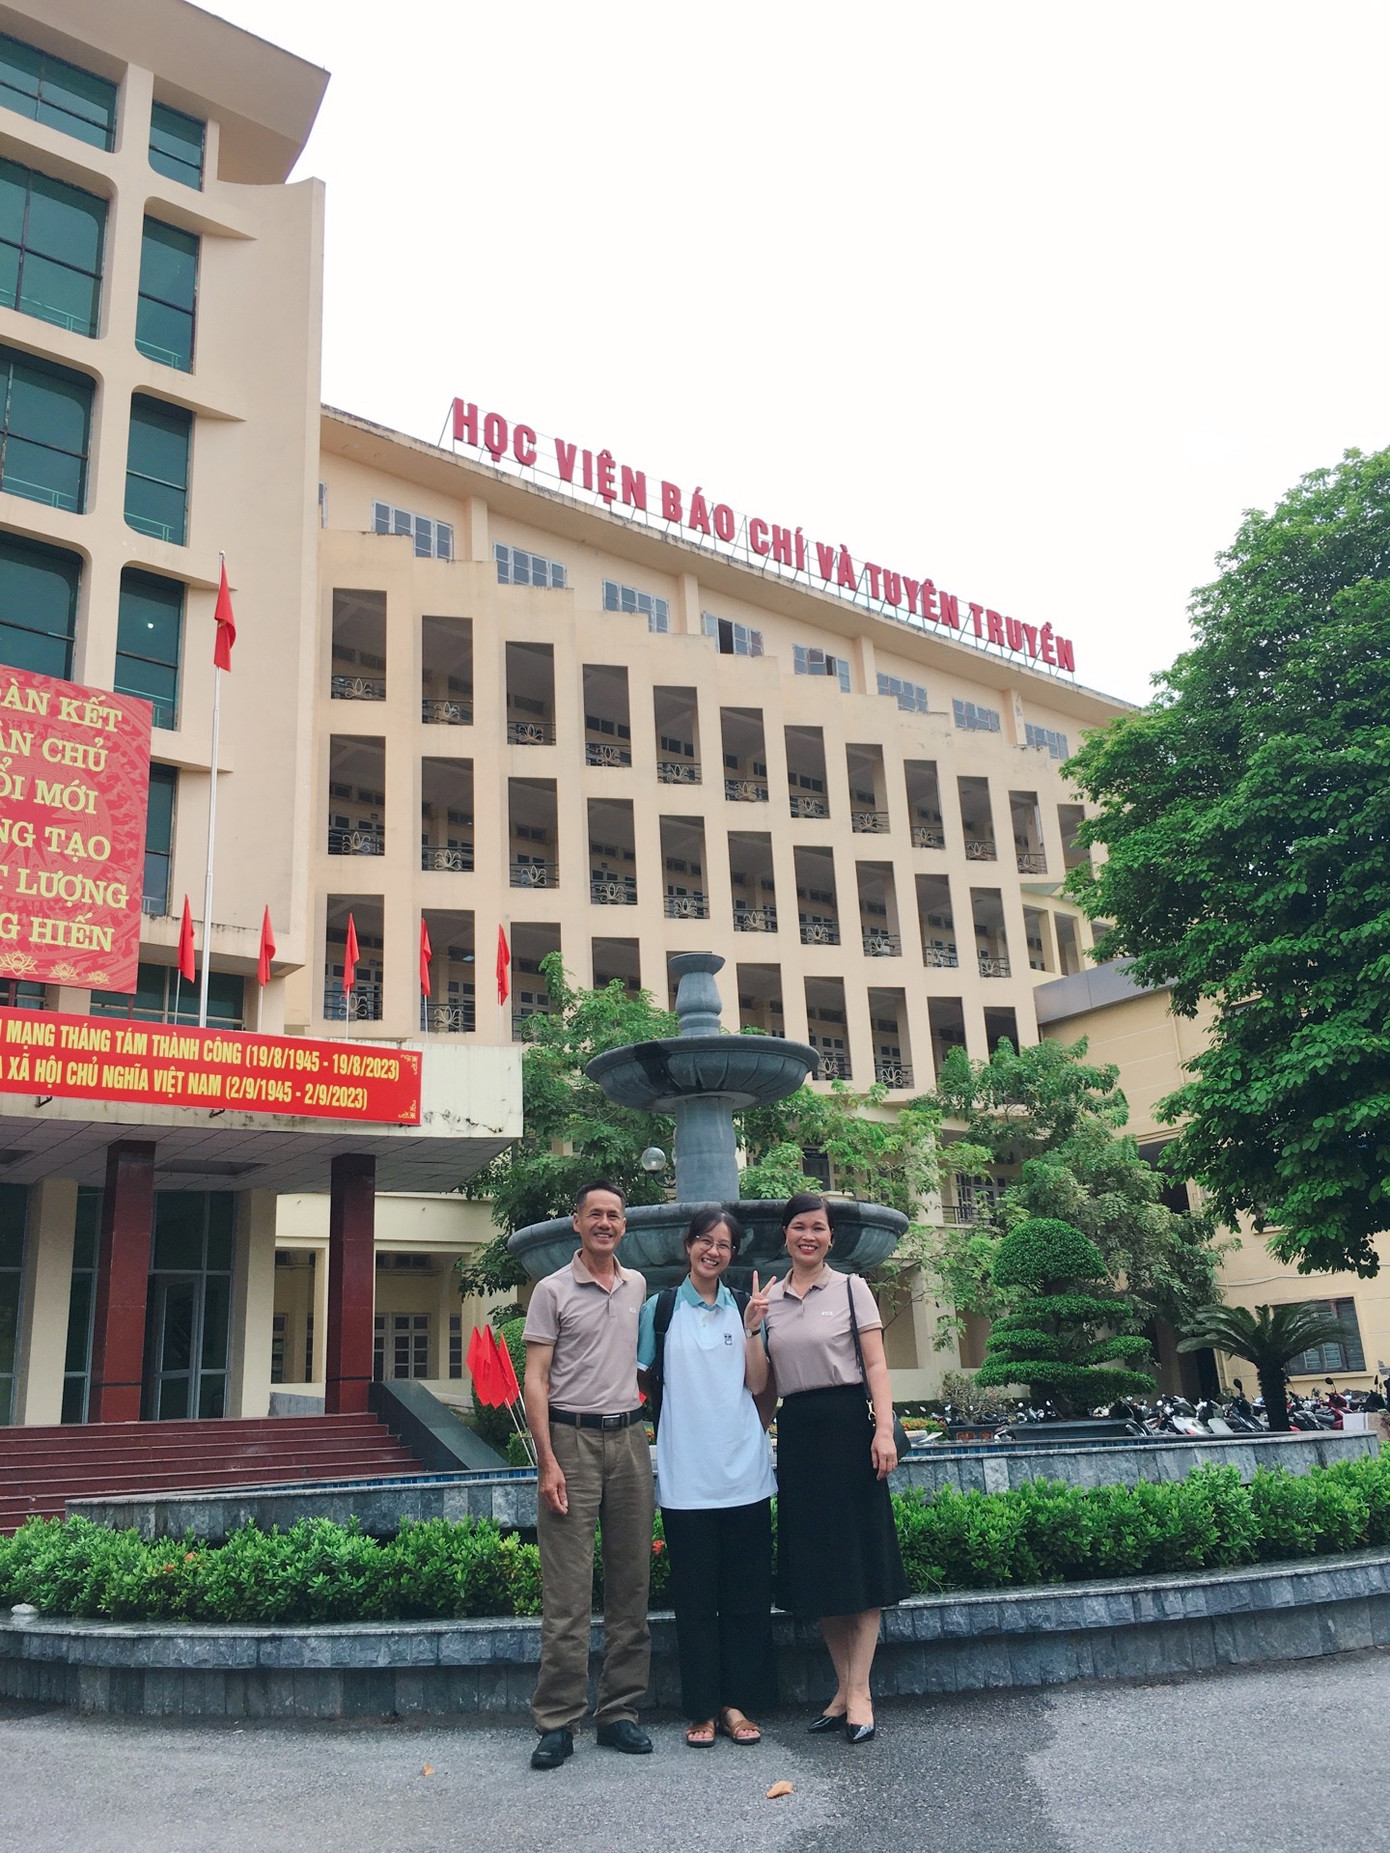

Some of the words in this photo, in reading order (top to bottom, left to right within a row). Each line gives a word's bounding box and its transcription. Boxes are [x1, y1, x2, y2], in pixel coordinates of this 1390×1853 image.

[453, 397, 537, 466] HỌC
[554, 437, 647, 510] VIỆN
[661, 480, 735, 542] BÁO
[749, 517, 805, 571] CHÍ
[816, 544, 857, 591] VÀ
[865, 562, 960, 630] TUYÊN
[968, 602, 1076, 672] TRUYỀN
[0, 677, 51, 716] ÀN
[58, 695, 122, 733] KẾT
[42, 737, 108, 772] CHỦ
[34, 779, 98, 815] MỚI
[45, 826, 111, 862] TẠO
[16, 868, 129, 908] LƯỢNG
[29, 912, 116, 952] HIẾN
[6, 1020, 56, 1050] MẠNG
[60, 1023, 111, 1053] THÁNG
[115, 1027, 148, 1056] TÁM
[152, 1032, 200, 1061] THÀNH
[203, 1037, 242, 1065] CÔNG
[246, 1044, 320, 1072] (19/8/1945
[333, 1054, 400, 1082] 19/8/2023)
[7, 1053, 30, 1081] XÃ
[34, 1055, 62, 1088] HỘI
[66, 1056, 99, 1087] CHỦ
[102, 1063, 149, 1091] NGHĨA
[153, 1066, 184, 1098] VIỆT
[187, 1072, 222, 1097] NAM
[226, 1075, 292, 1103] (2/9/1945
[304, 1083, 368, 1111] 2/9/2023)
